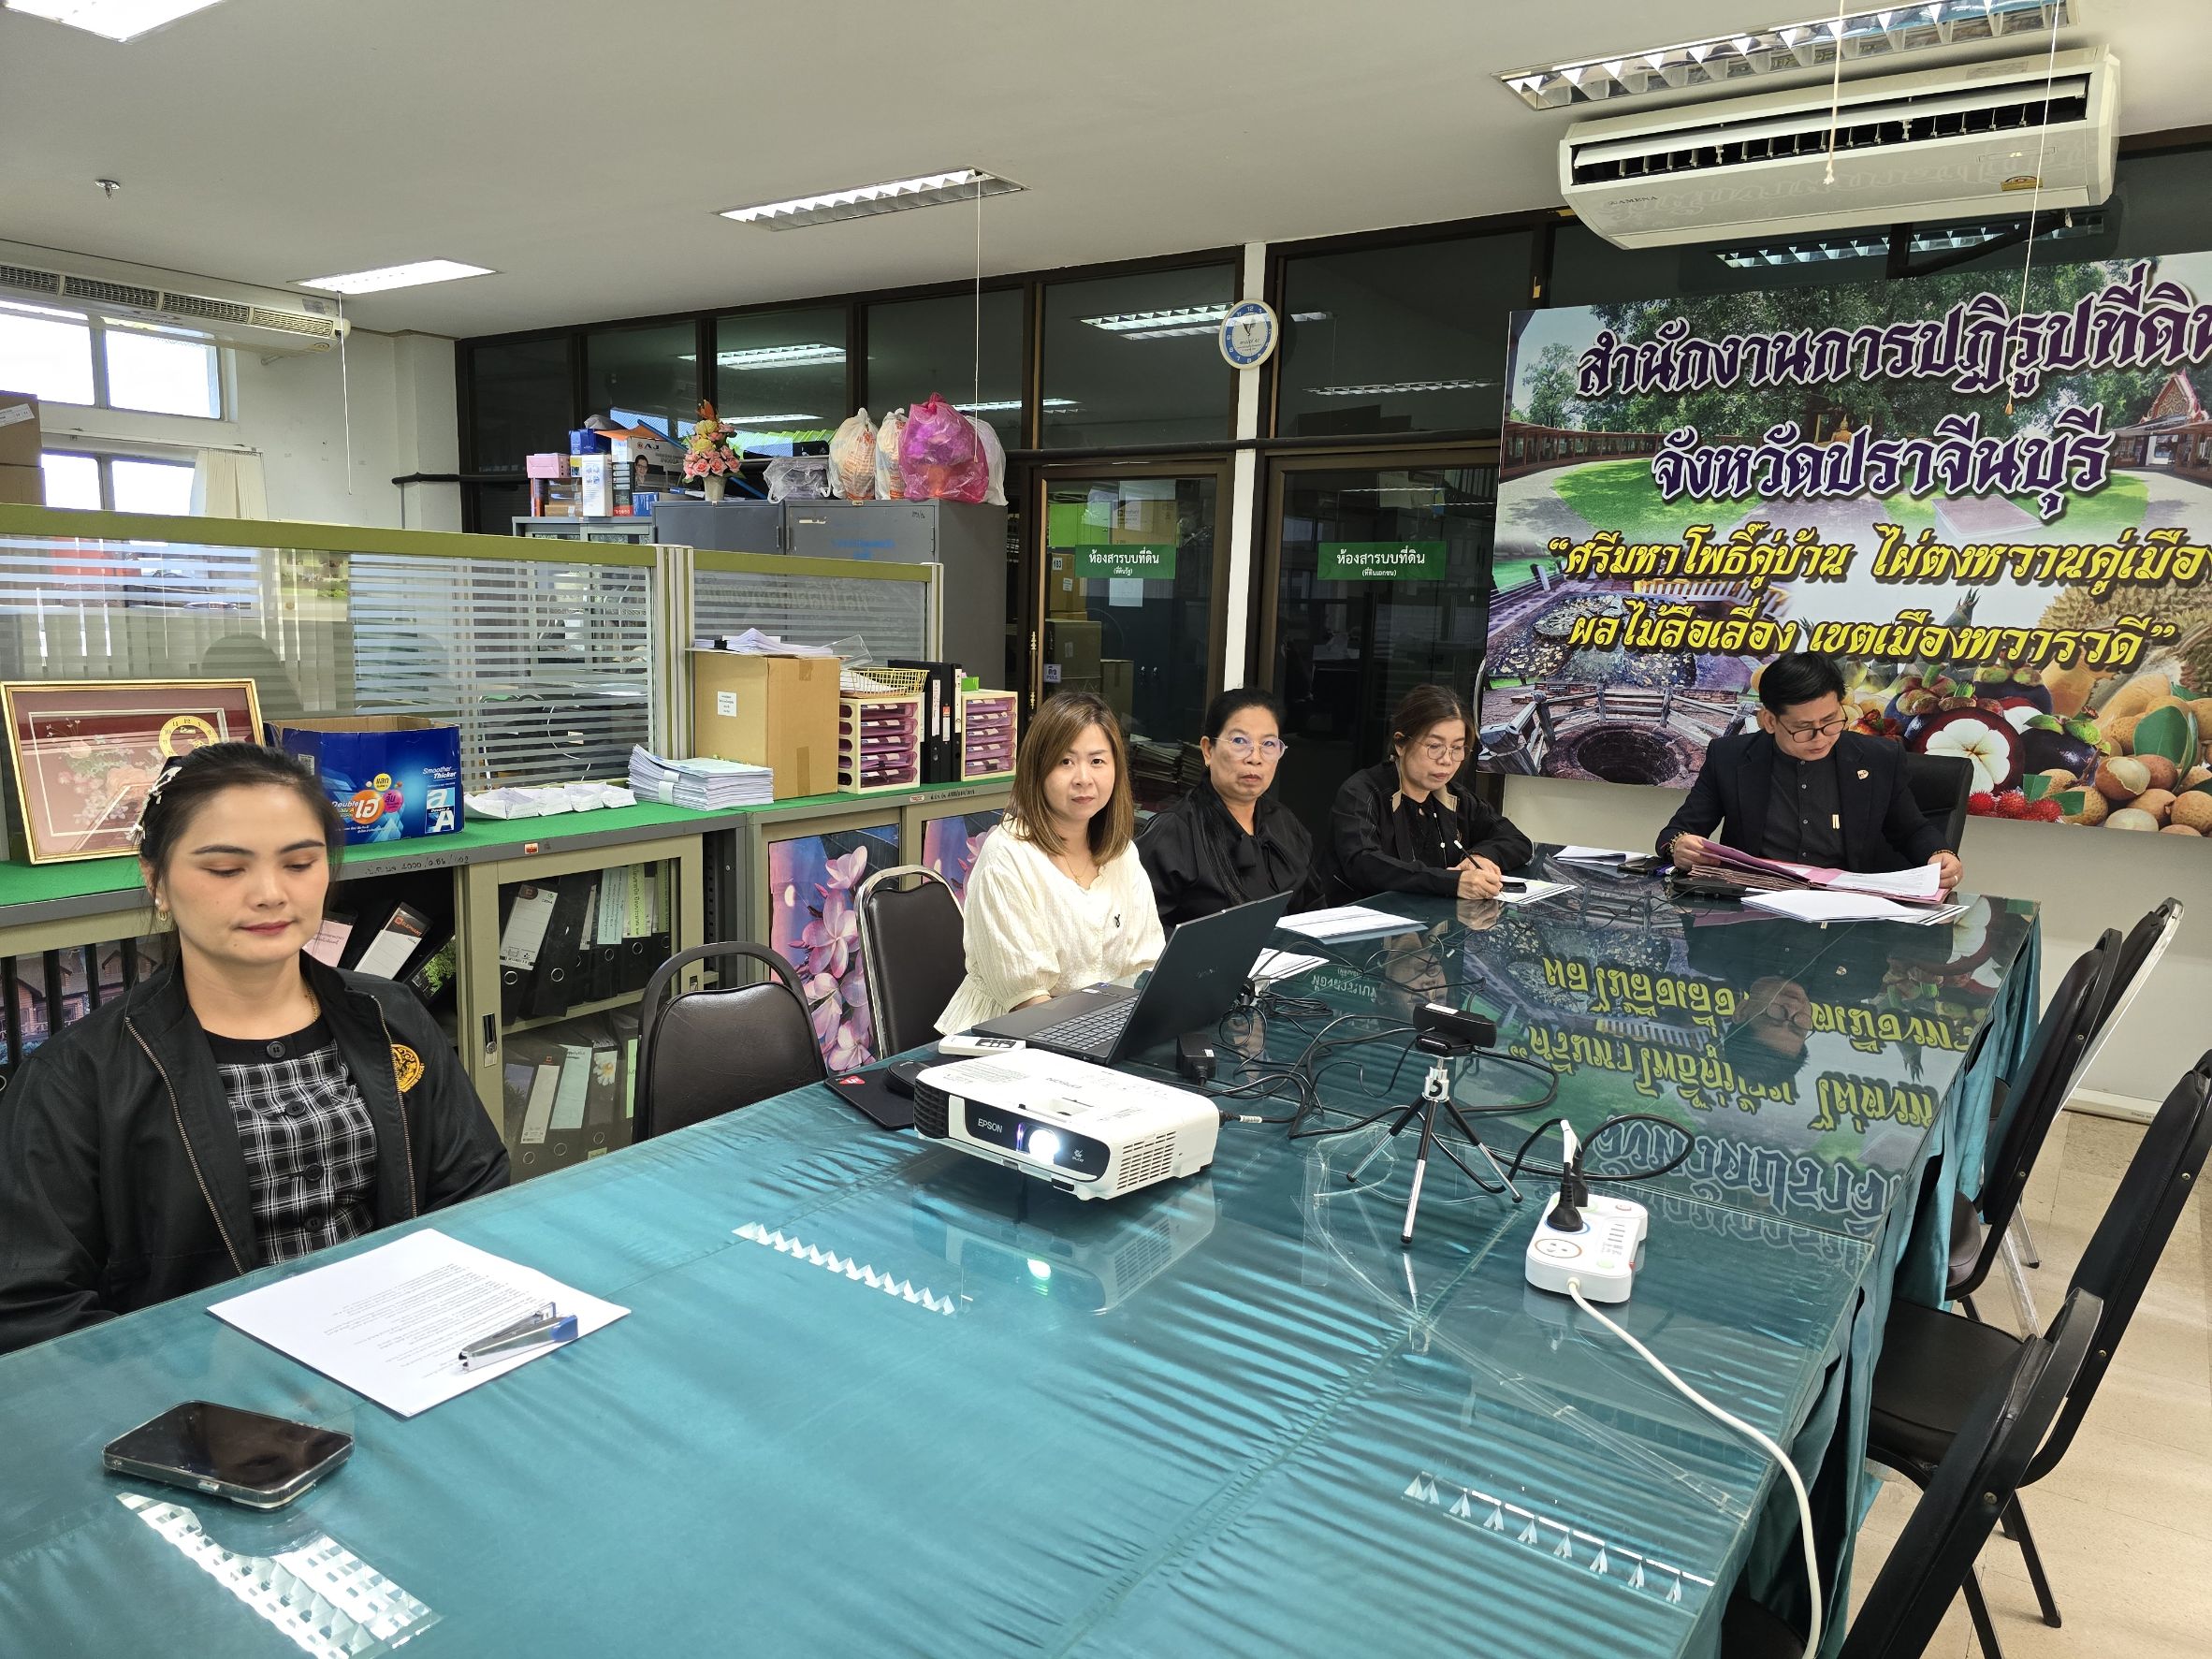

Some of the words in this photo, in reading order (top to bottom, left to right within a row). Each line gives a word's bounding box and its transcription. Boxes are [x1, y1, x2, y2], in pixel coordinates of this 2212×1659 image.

[1651, 402, 2116, 520] จังหวัดปราจีนบุรี
[1088, 546, 1159, 564] ห้องสารบบที่ดิน
[1336, 546, 1426, 565] ห้องสารบบที่ดิน
[1870, 524, 2212, 598] ไผ่ตงหวานคู่เมือ
[1567, 596, 1799, 653] ผลไม้ลือเลื่อง
[978, 1118, 1003, 1133] EPSON
